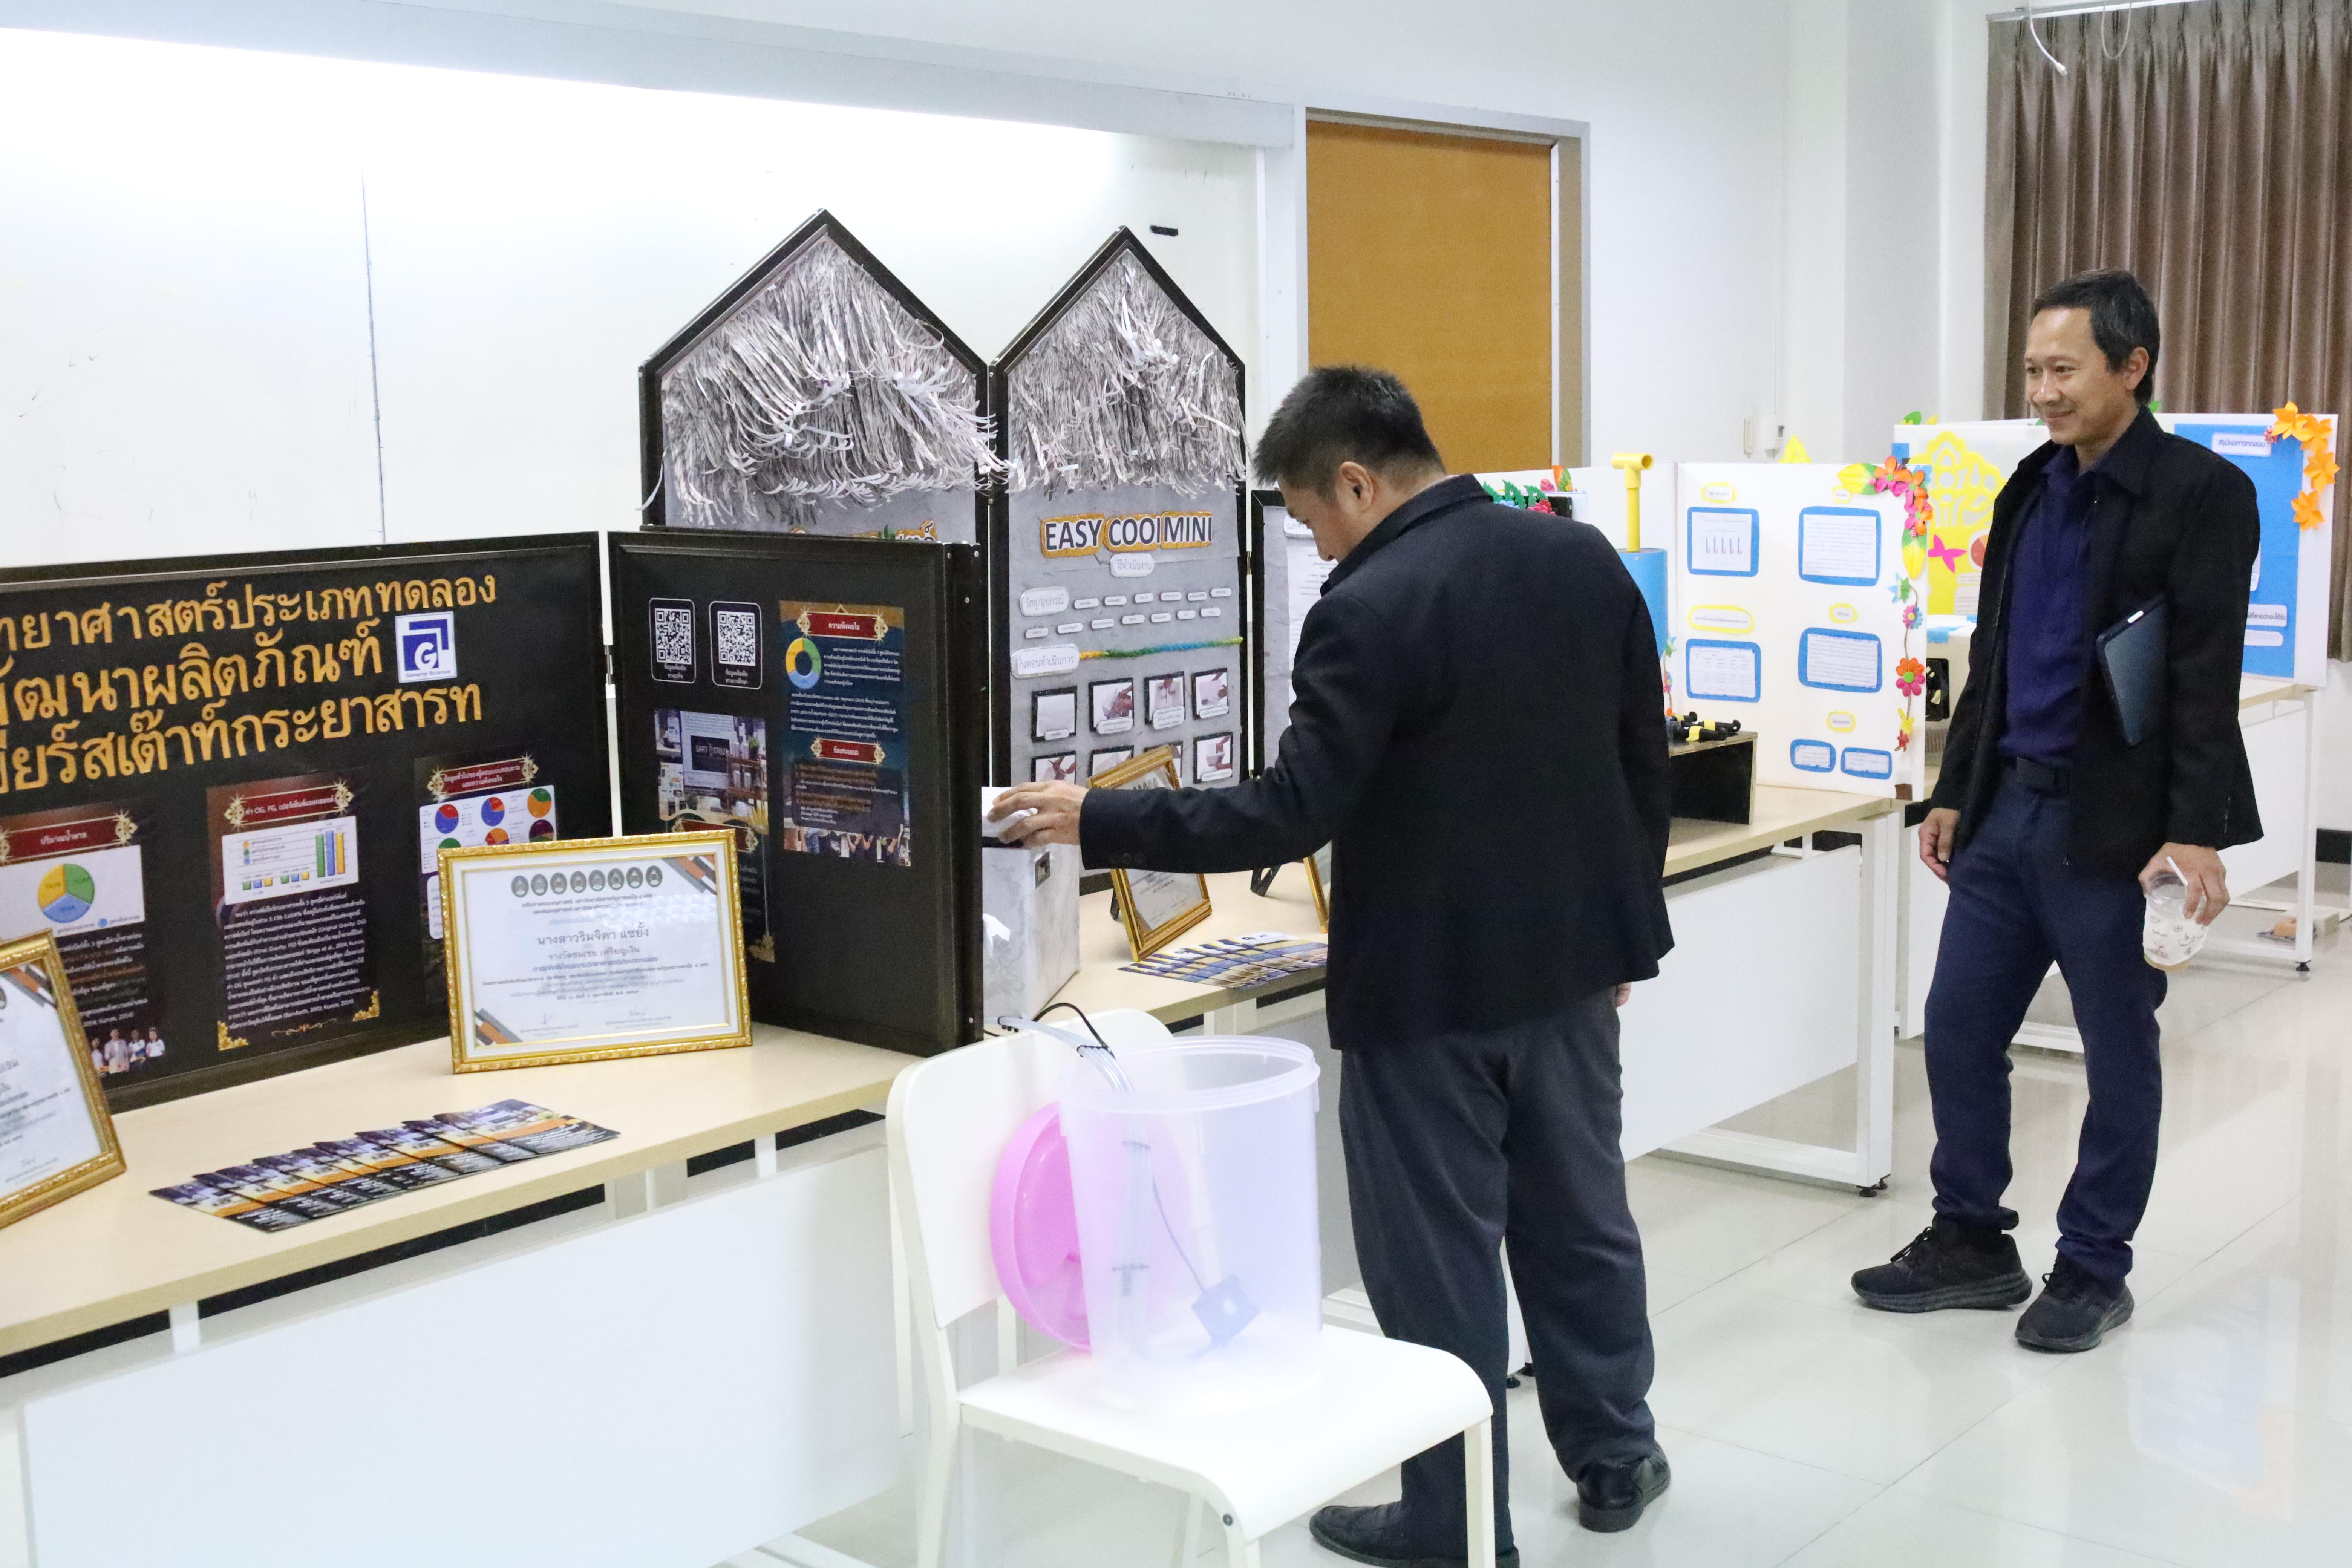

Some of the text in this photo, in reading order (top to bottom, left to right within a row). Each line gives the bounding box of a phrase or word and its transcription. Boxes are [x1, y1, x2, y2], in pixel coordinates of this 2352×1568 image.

[1046, 519, 1103, 550] EASY
[1164, 516, 1212, 542] MINI
[1116, 559, 1152, 570] วิธีดำเนินงาน
[1025, 594, 1064, 610] วัสดุ/อุปกรณ์
[1019, 654, 1074, 669] ั้นตอนดำเนินการ
